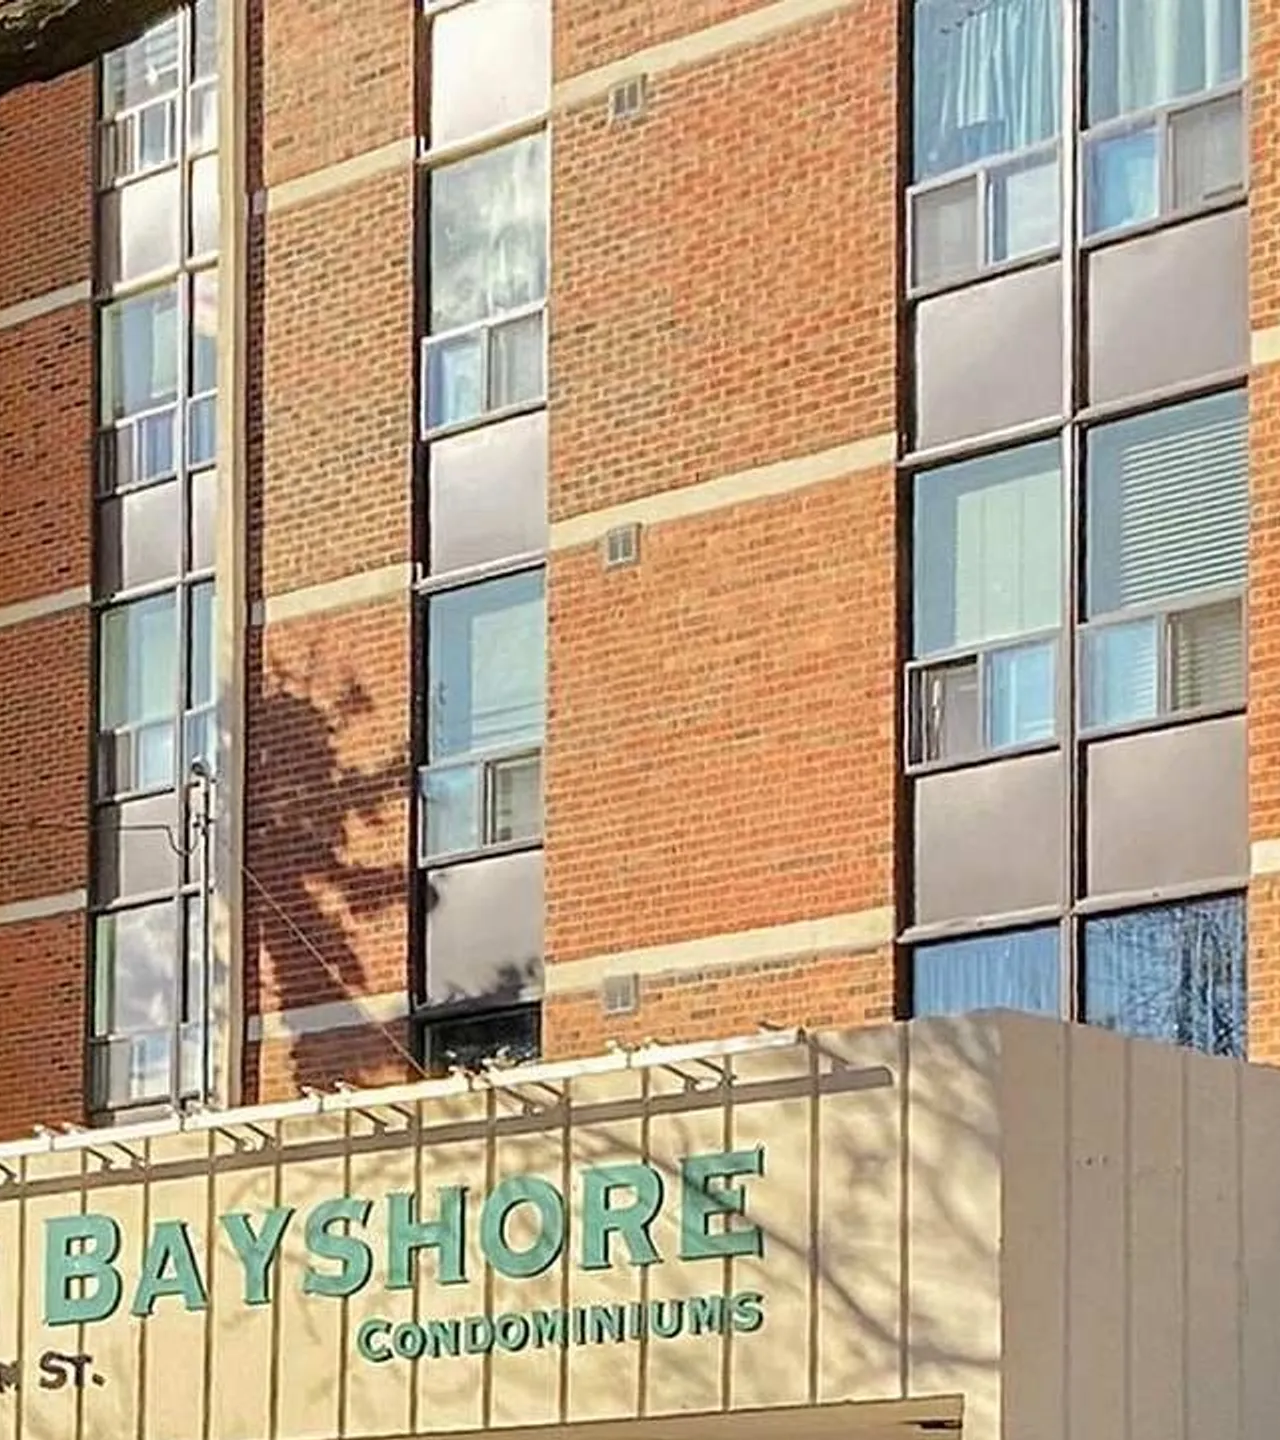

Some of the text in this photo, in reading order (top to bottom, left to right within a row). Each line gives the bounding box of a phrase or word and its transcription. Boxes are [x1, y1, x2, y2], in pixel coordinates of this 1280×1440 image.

[43, 1142, 766, 1327] BAYSHORE
[357, 1291, 764, 1362] CONDOMINIUMS
[39, 1351, 105, 1389] ST.
